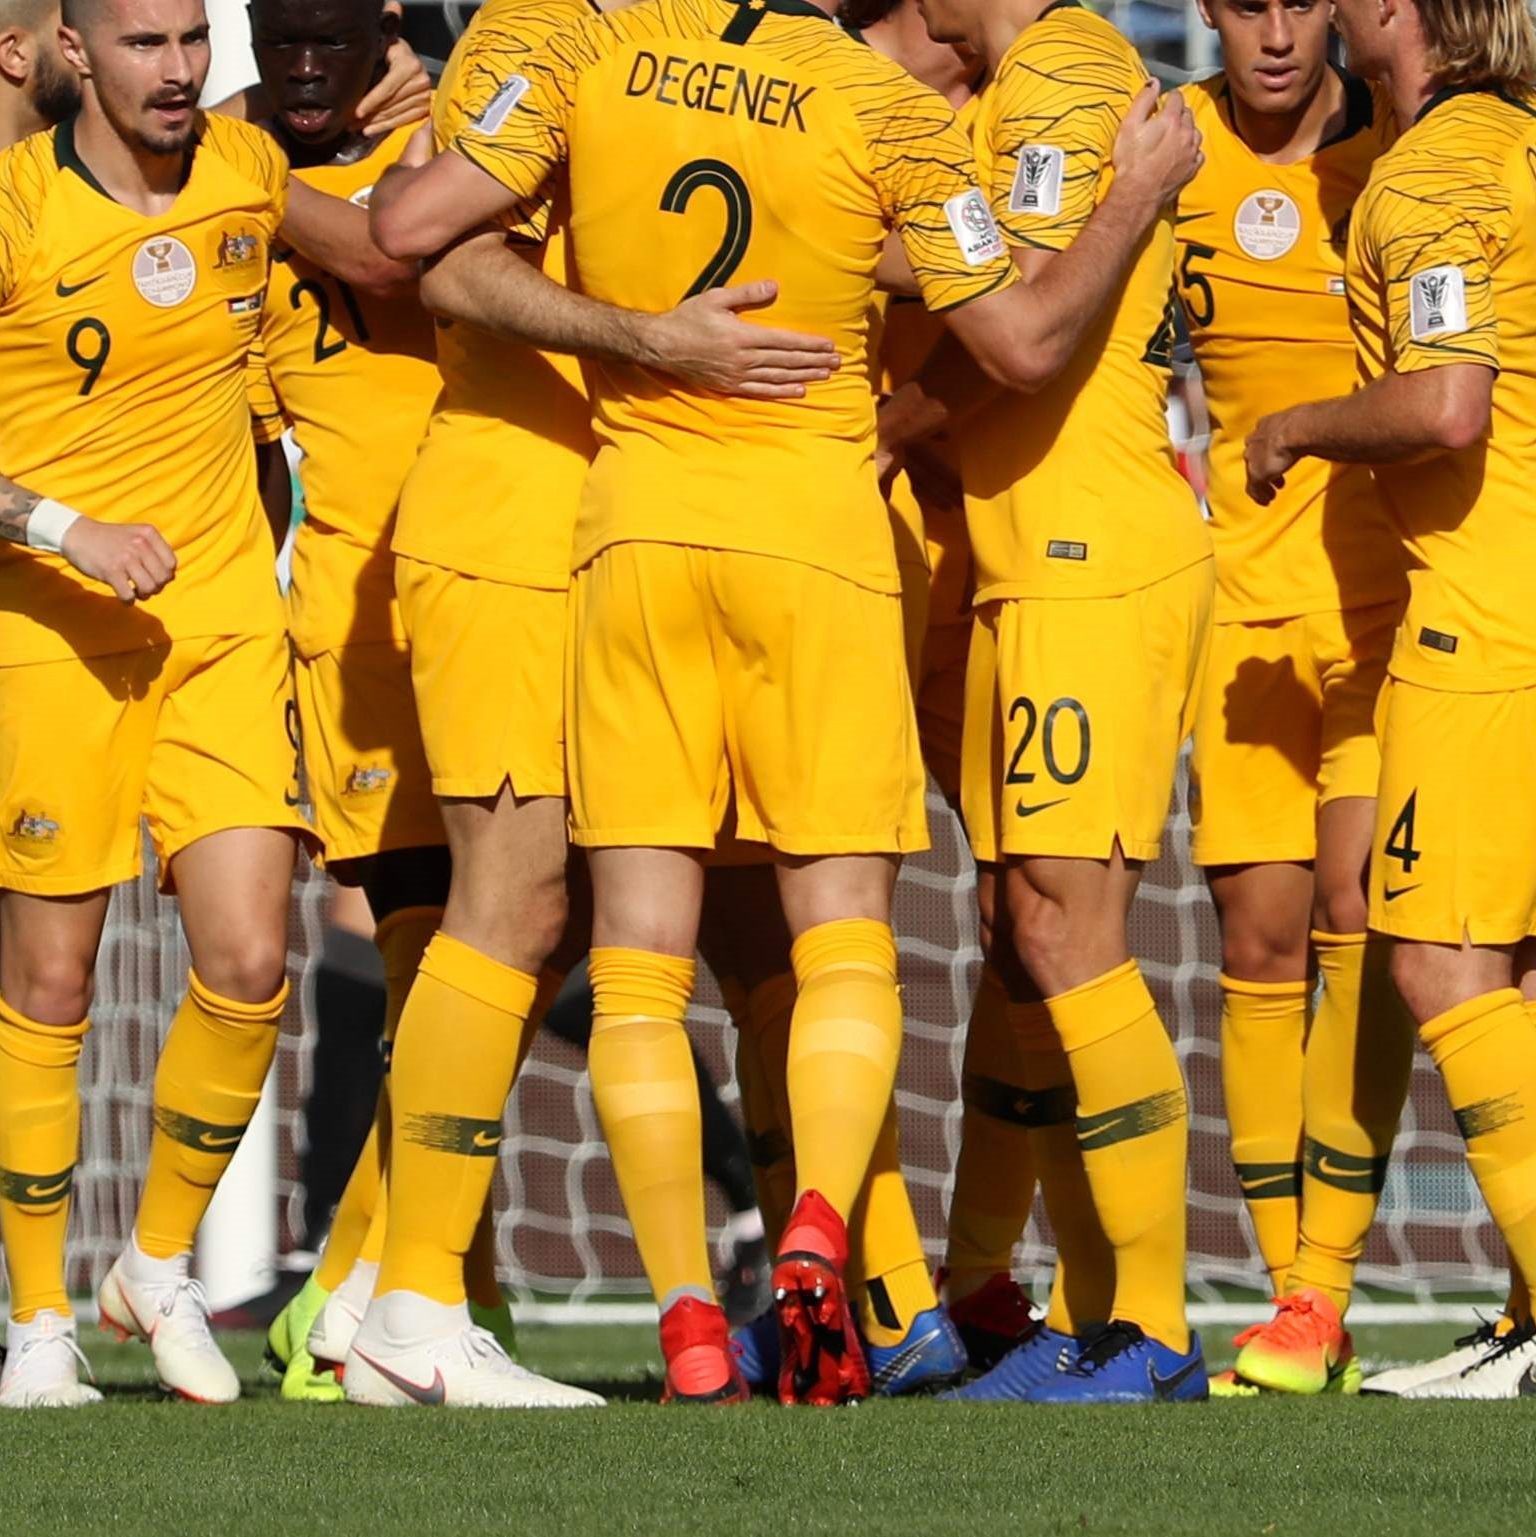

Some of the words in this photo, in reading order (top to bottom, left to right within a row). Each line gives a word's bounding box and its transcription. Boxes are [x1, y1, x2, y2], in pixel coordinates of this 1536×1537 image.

[625, 50, 818, 133] DEGENEK
[659, 157, 753, 306] 2
[66, 316, 112, 396] 9
[289, 272, 371, 364] 21
[1005, 695, 1091, 785] 20
[1383, 786, 1422, 874] 4
